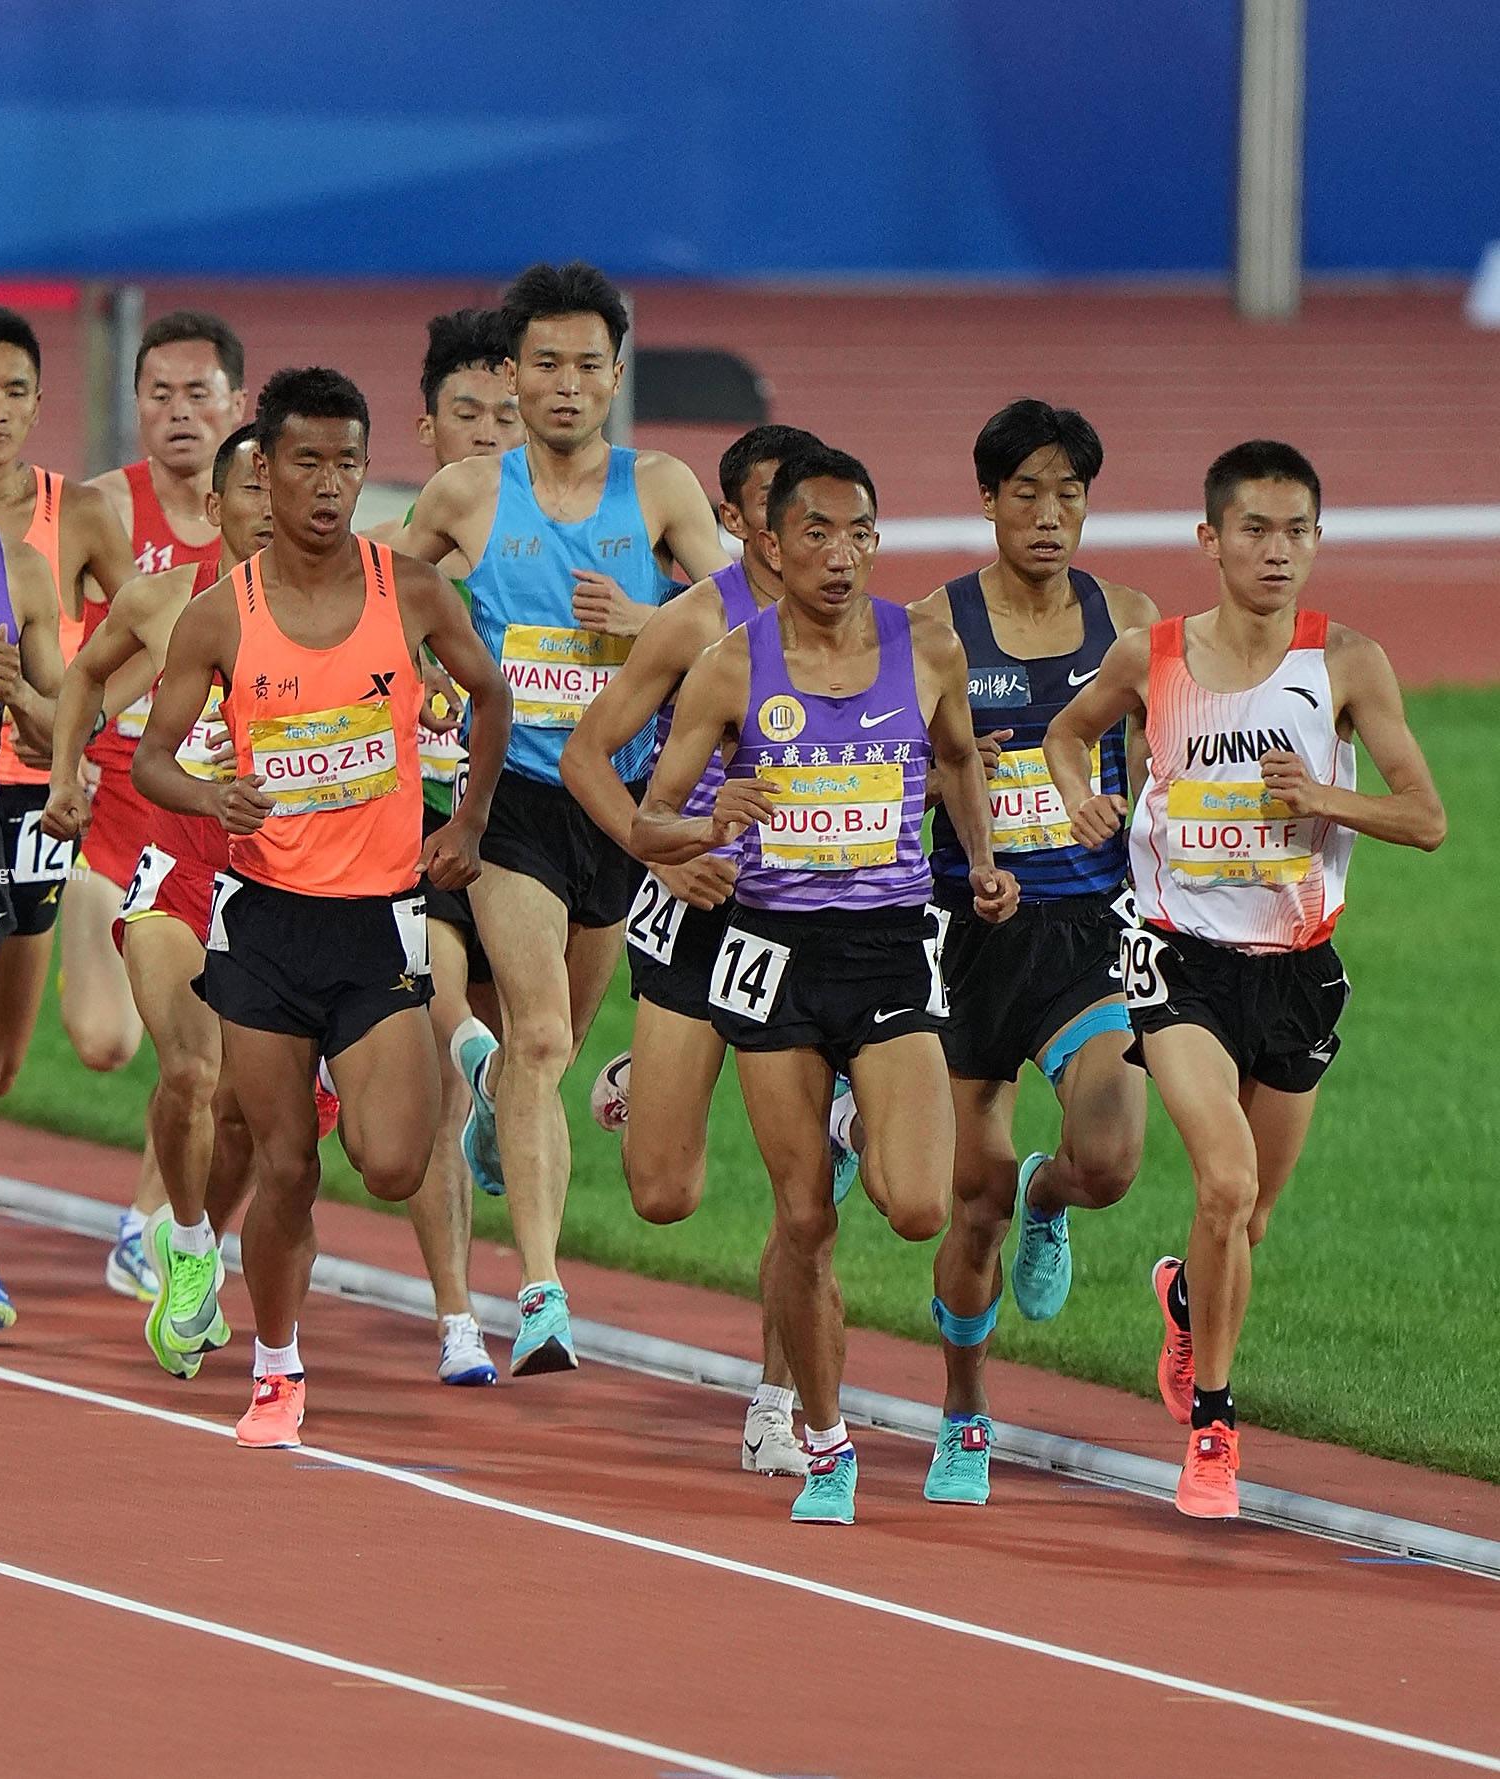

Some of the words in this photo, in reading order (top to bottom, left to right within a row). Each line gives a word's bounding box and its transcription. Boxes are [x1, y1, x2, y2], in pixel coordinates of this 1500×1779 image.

[265, 739, 387, 780] GUO.Z.R
[759, 743, 911, 767] 西藏拉萨城投
[1186, 728, 1296, 770] YUNNAN
[770, 807, 888, 834] DUO.B.J
[1181, 824, 1297, 849] LUO.T.F
[628, 879, 677, 954] 24
[720, 938, 773, 1011] 14
